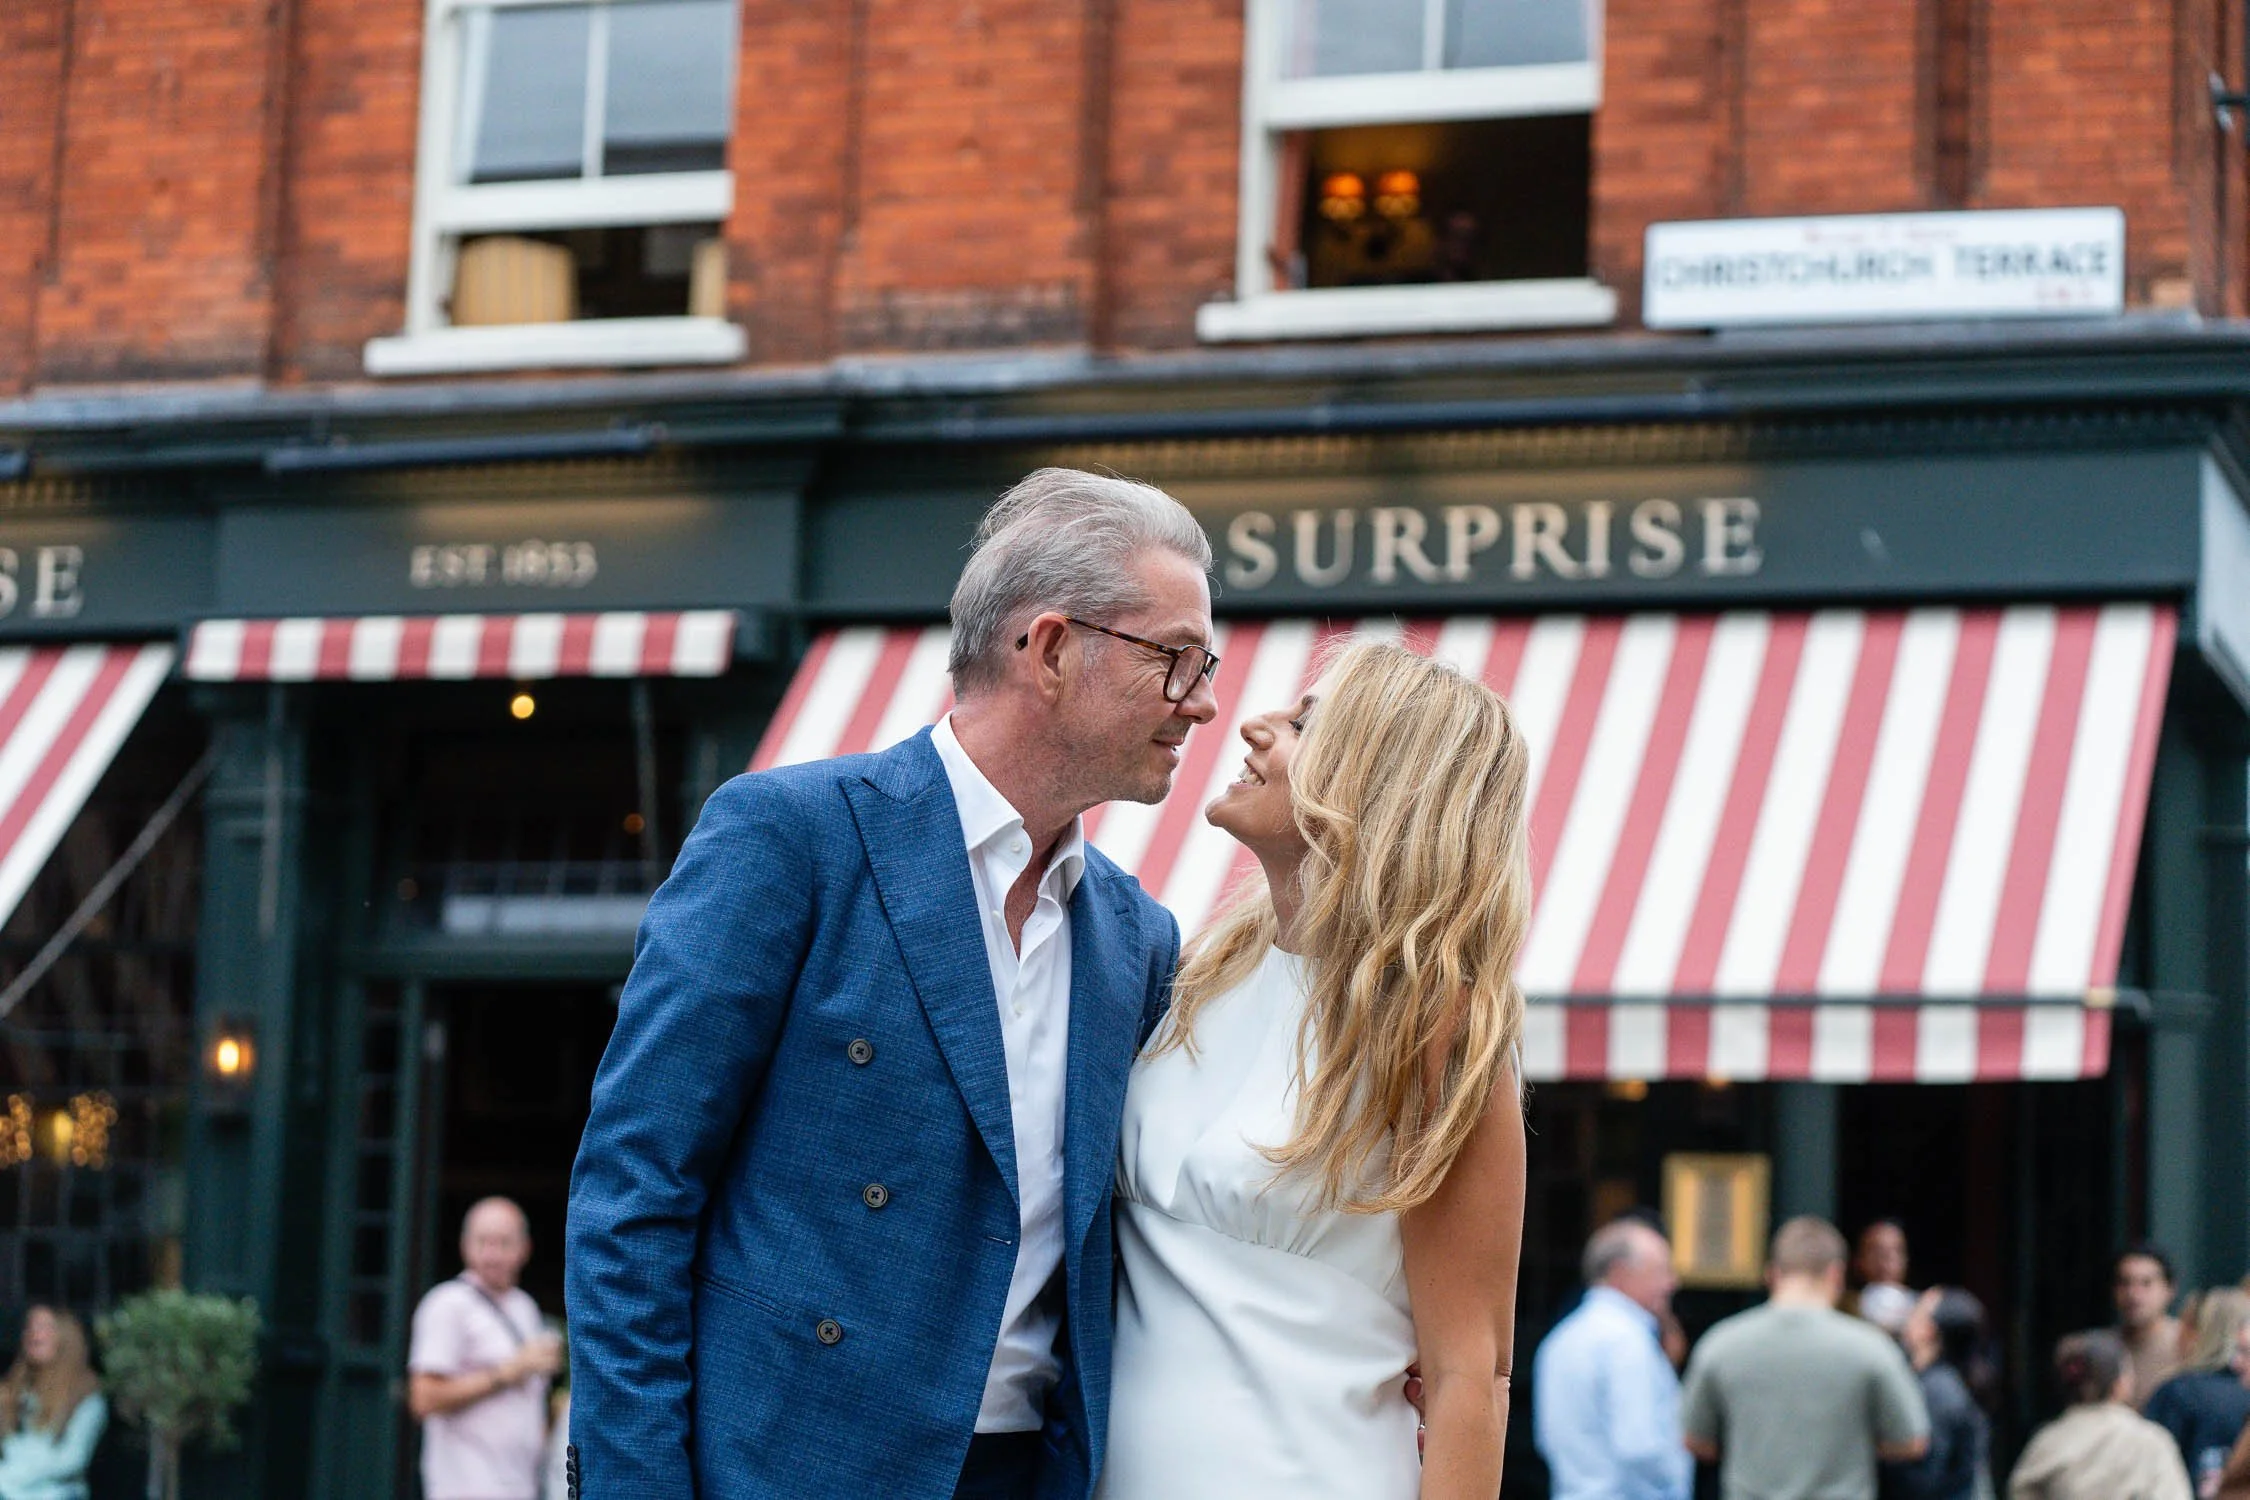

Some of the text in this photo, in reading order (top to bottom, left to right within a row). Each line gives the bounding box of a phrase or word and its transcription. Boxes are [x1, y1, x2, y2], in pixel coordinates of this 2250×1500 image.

[1658, 240, 2109, 289] CHRISTCHURCH TERRACE
[410, 544, 496, 588] EST
[1225, 498, 1764, 590] SURPRISE
